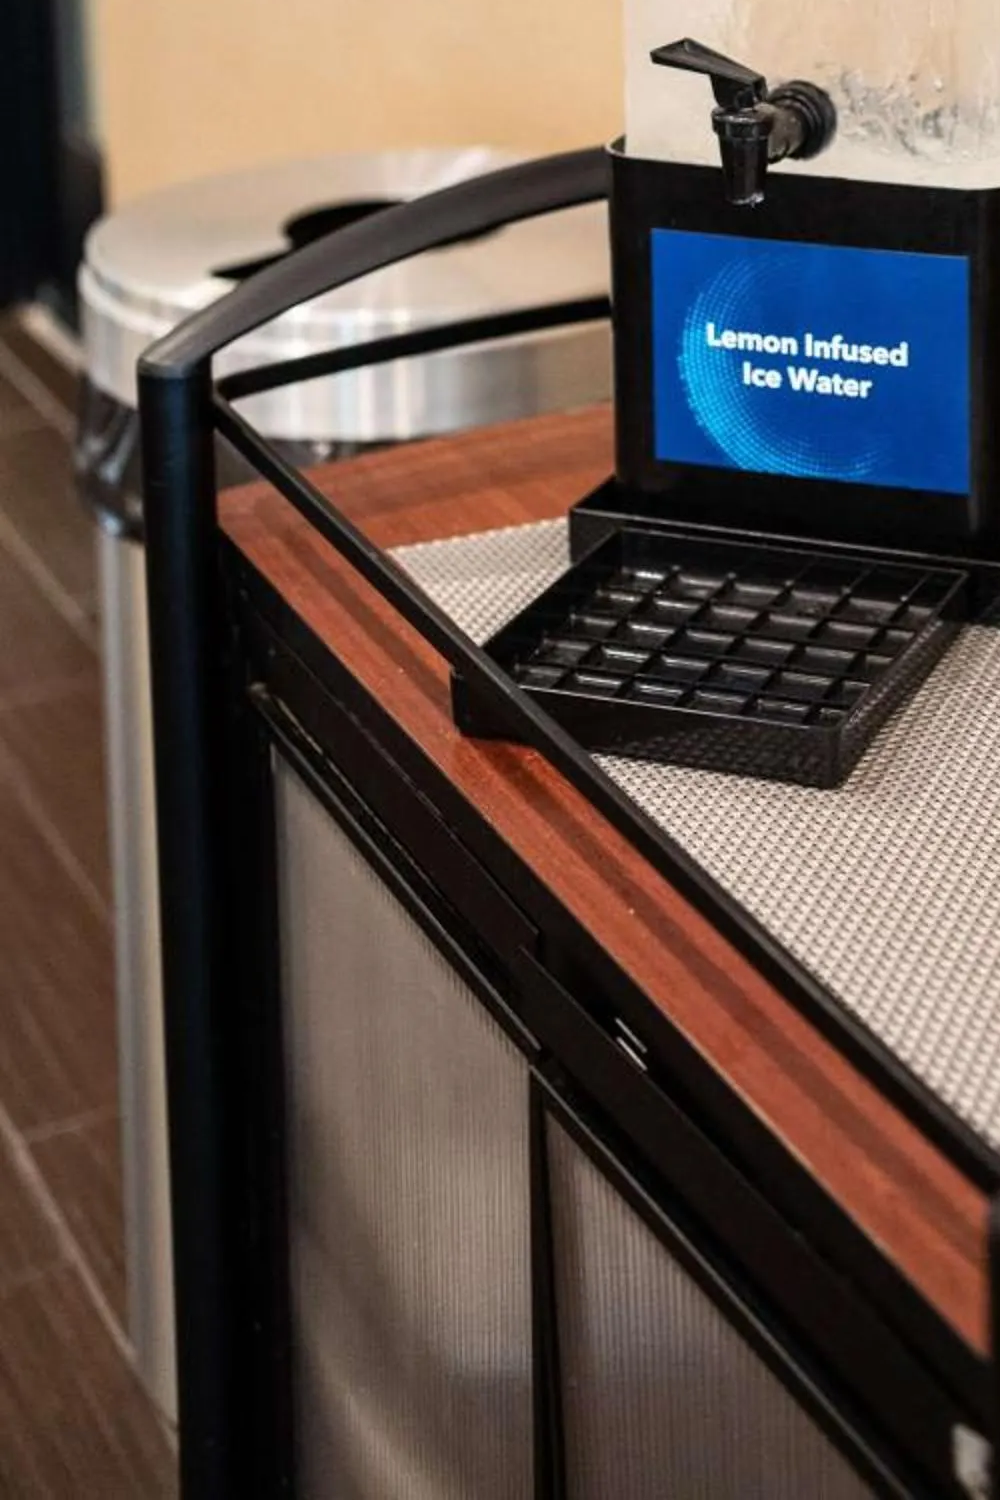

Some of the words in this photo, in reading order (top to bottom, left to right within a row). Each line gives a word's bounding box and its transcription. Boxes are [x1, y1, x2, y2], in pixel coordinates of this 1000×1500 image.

[706, 322, 798, 356] Lemon
[804, 333, 908, 367] Infused
[743, 361, 782, 389] Ice
[787, 366, 873, 398] Water
